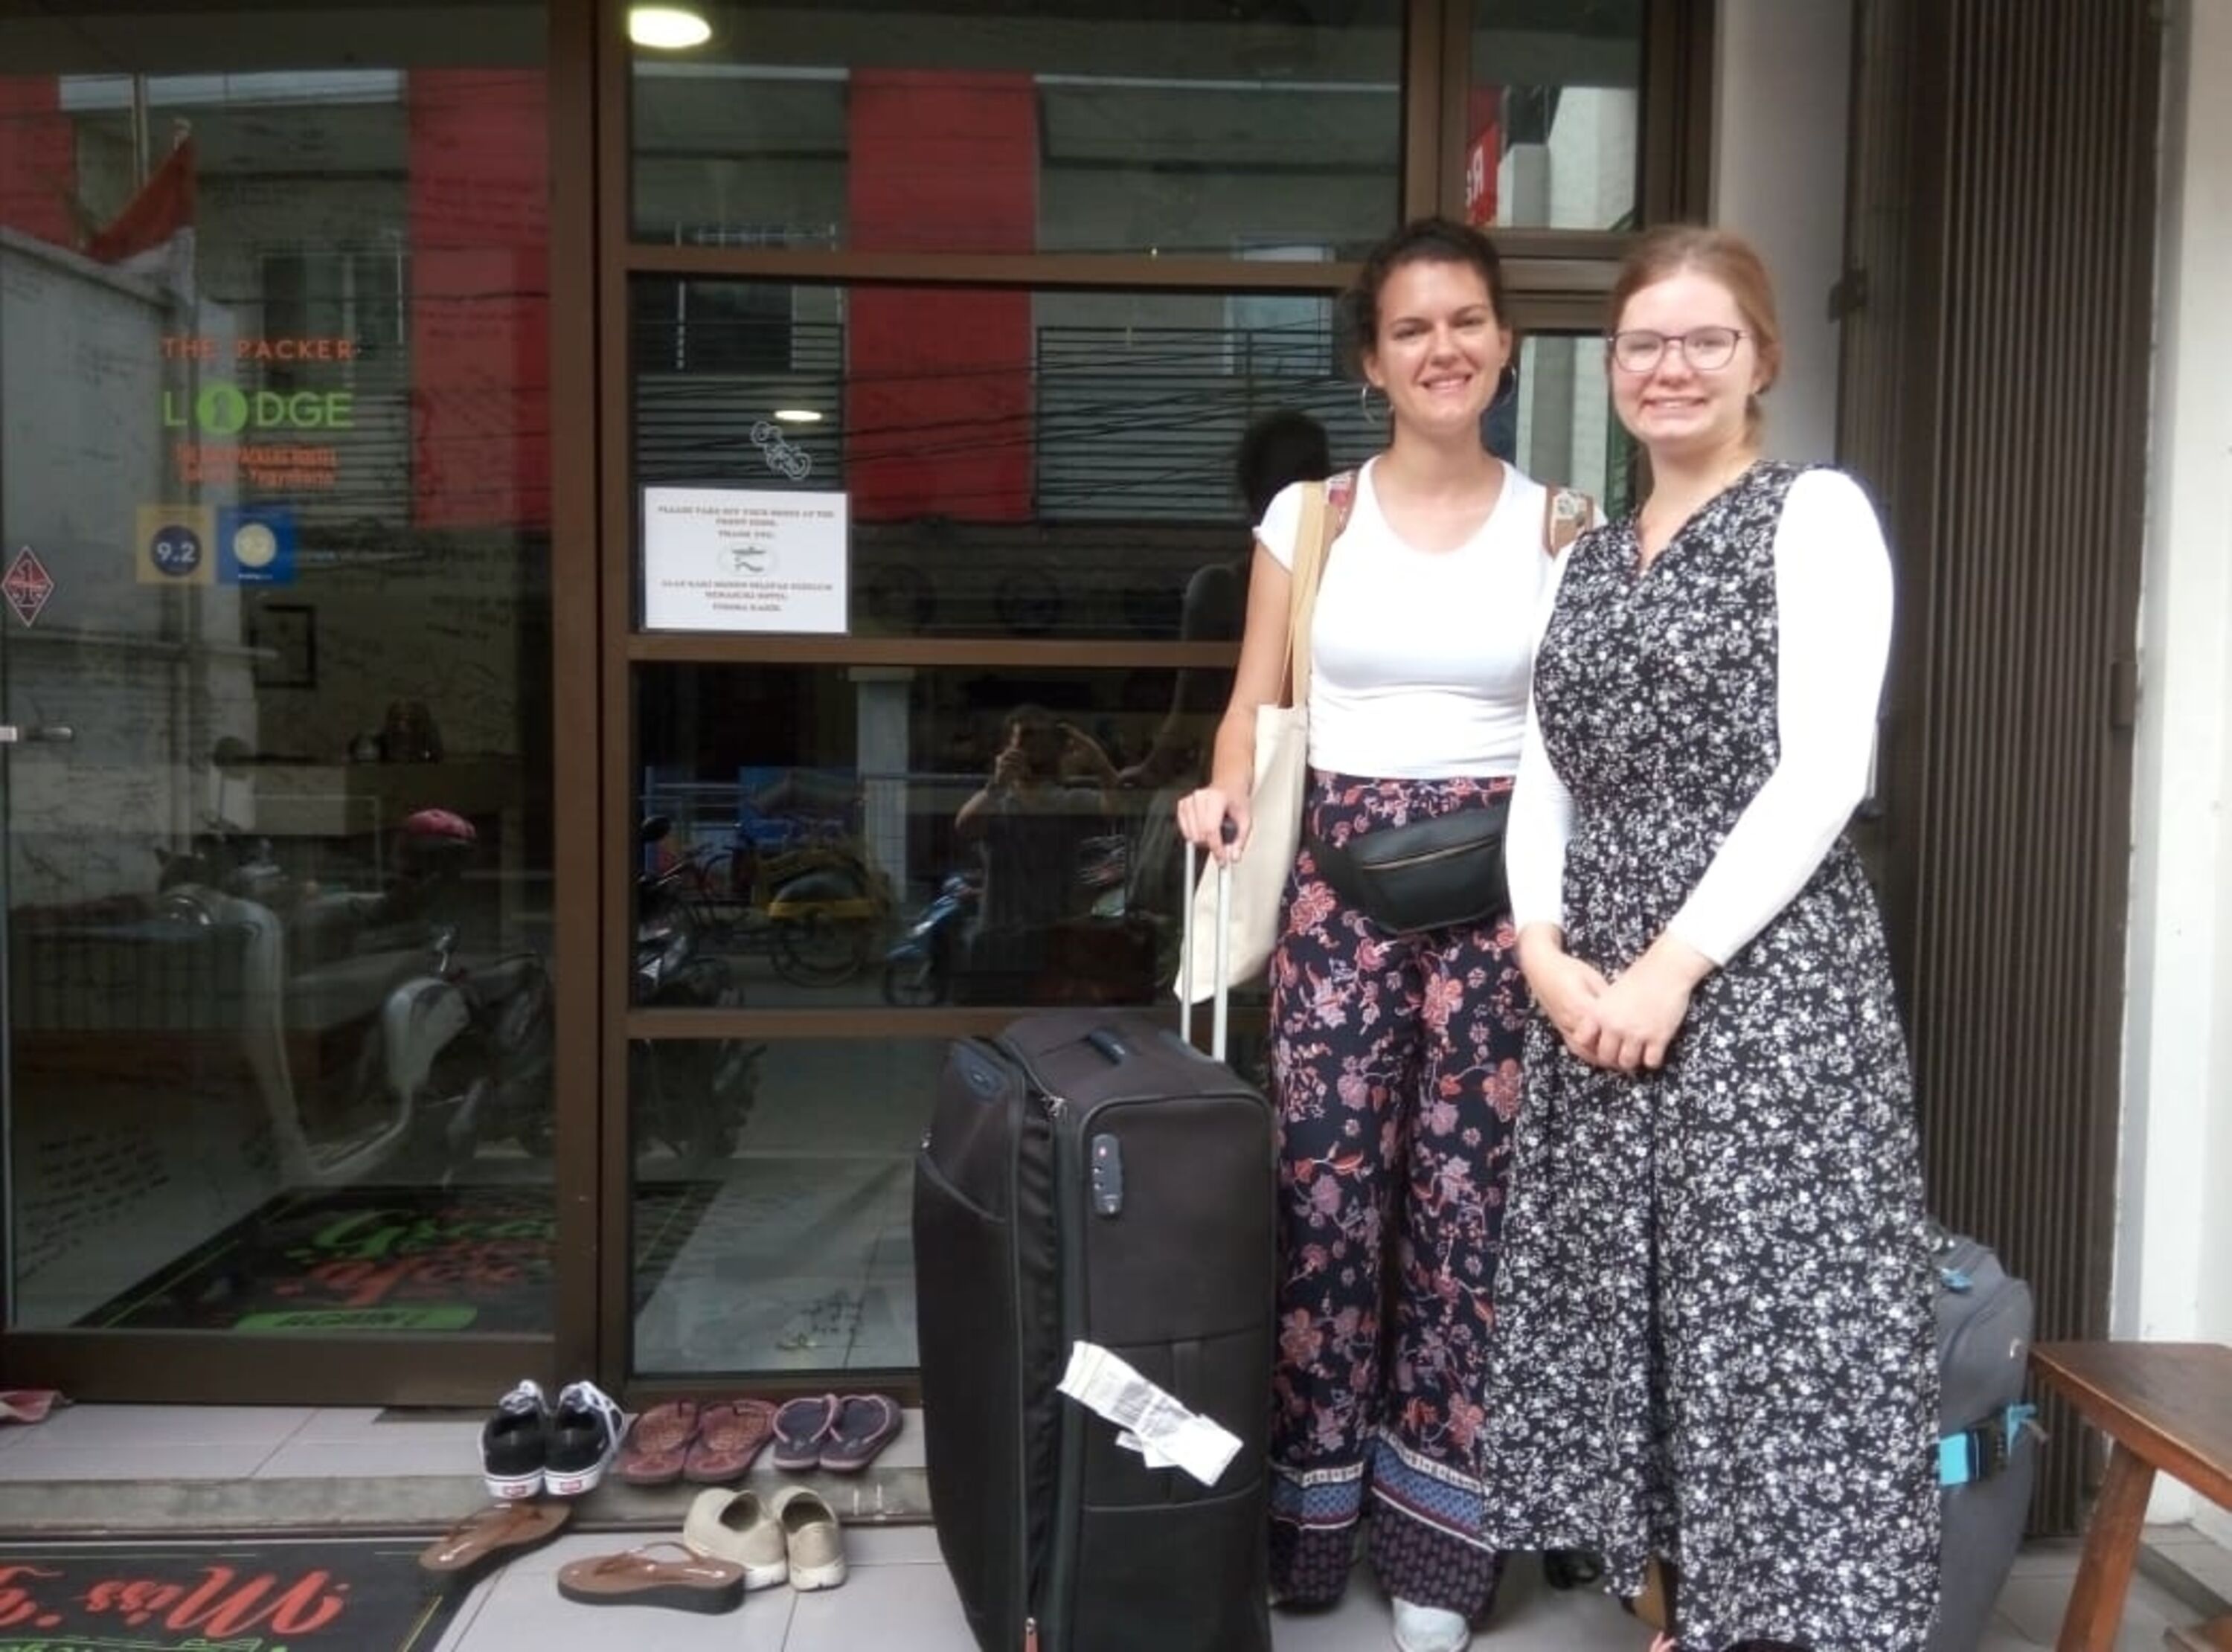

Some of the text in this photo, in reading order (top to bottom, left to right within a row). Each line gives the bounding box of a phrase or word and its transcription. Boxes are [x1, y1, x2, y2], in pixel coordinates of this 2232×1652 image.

[163, 338, 353, 360] THE PACKER
[156, 541, 196, 563] 9.2
[74, 1566, 349, 1637] Miss
